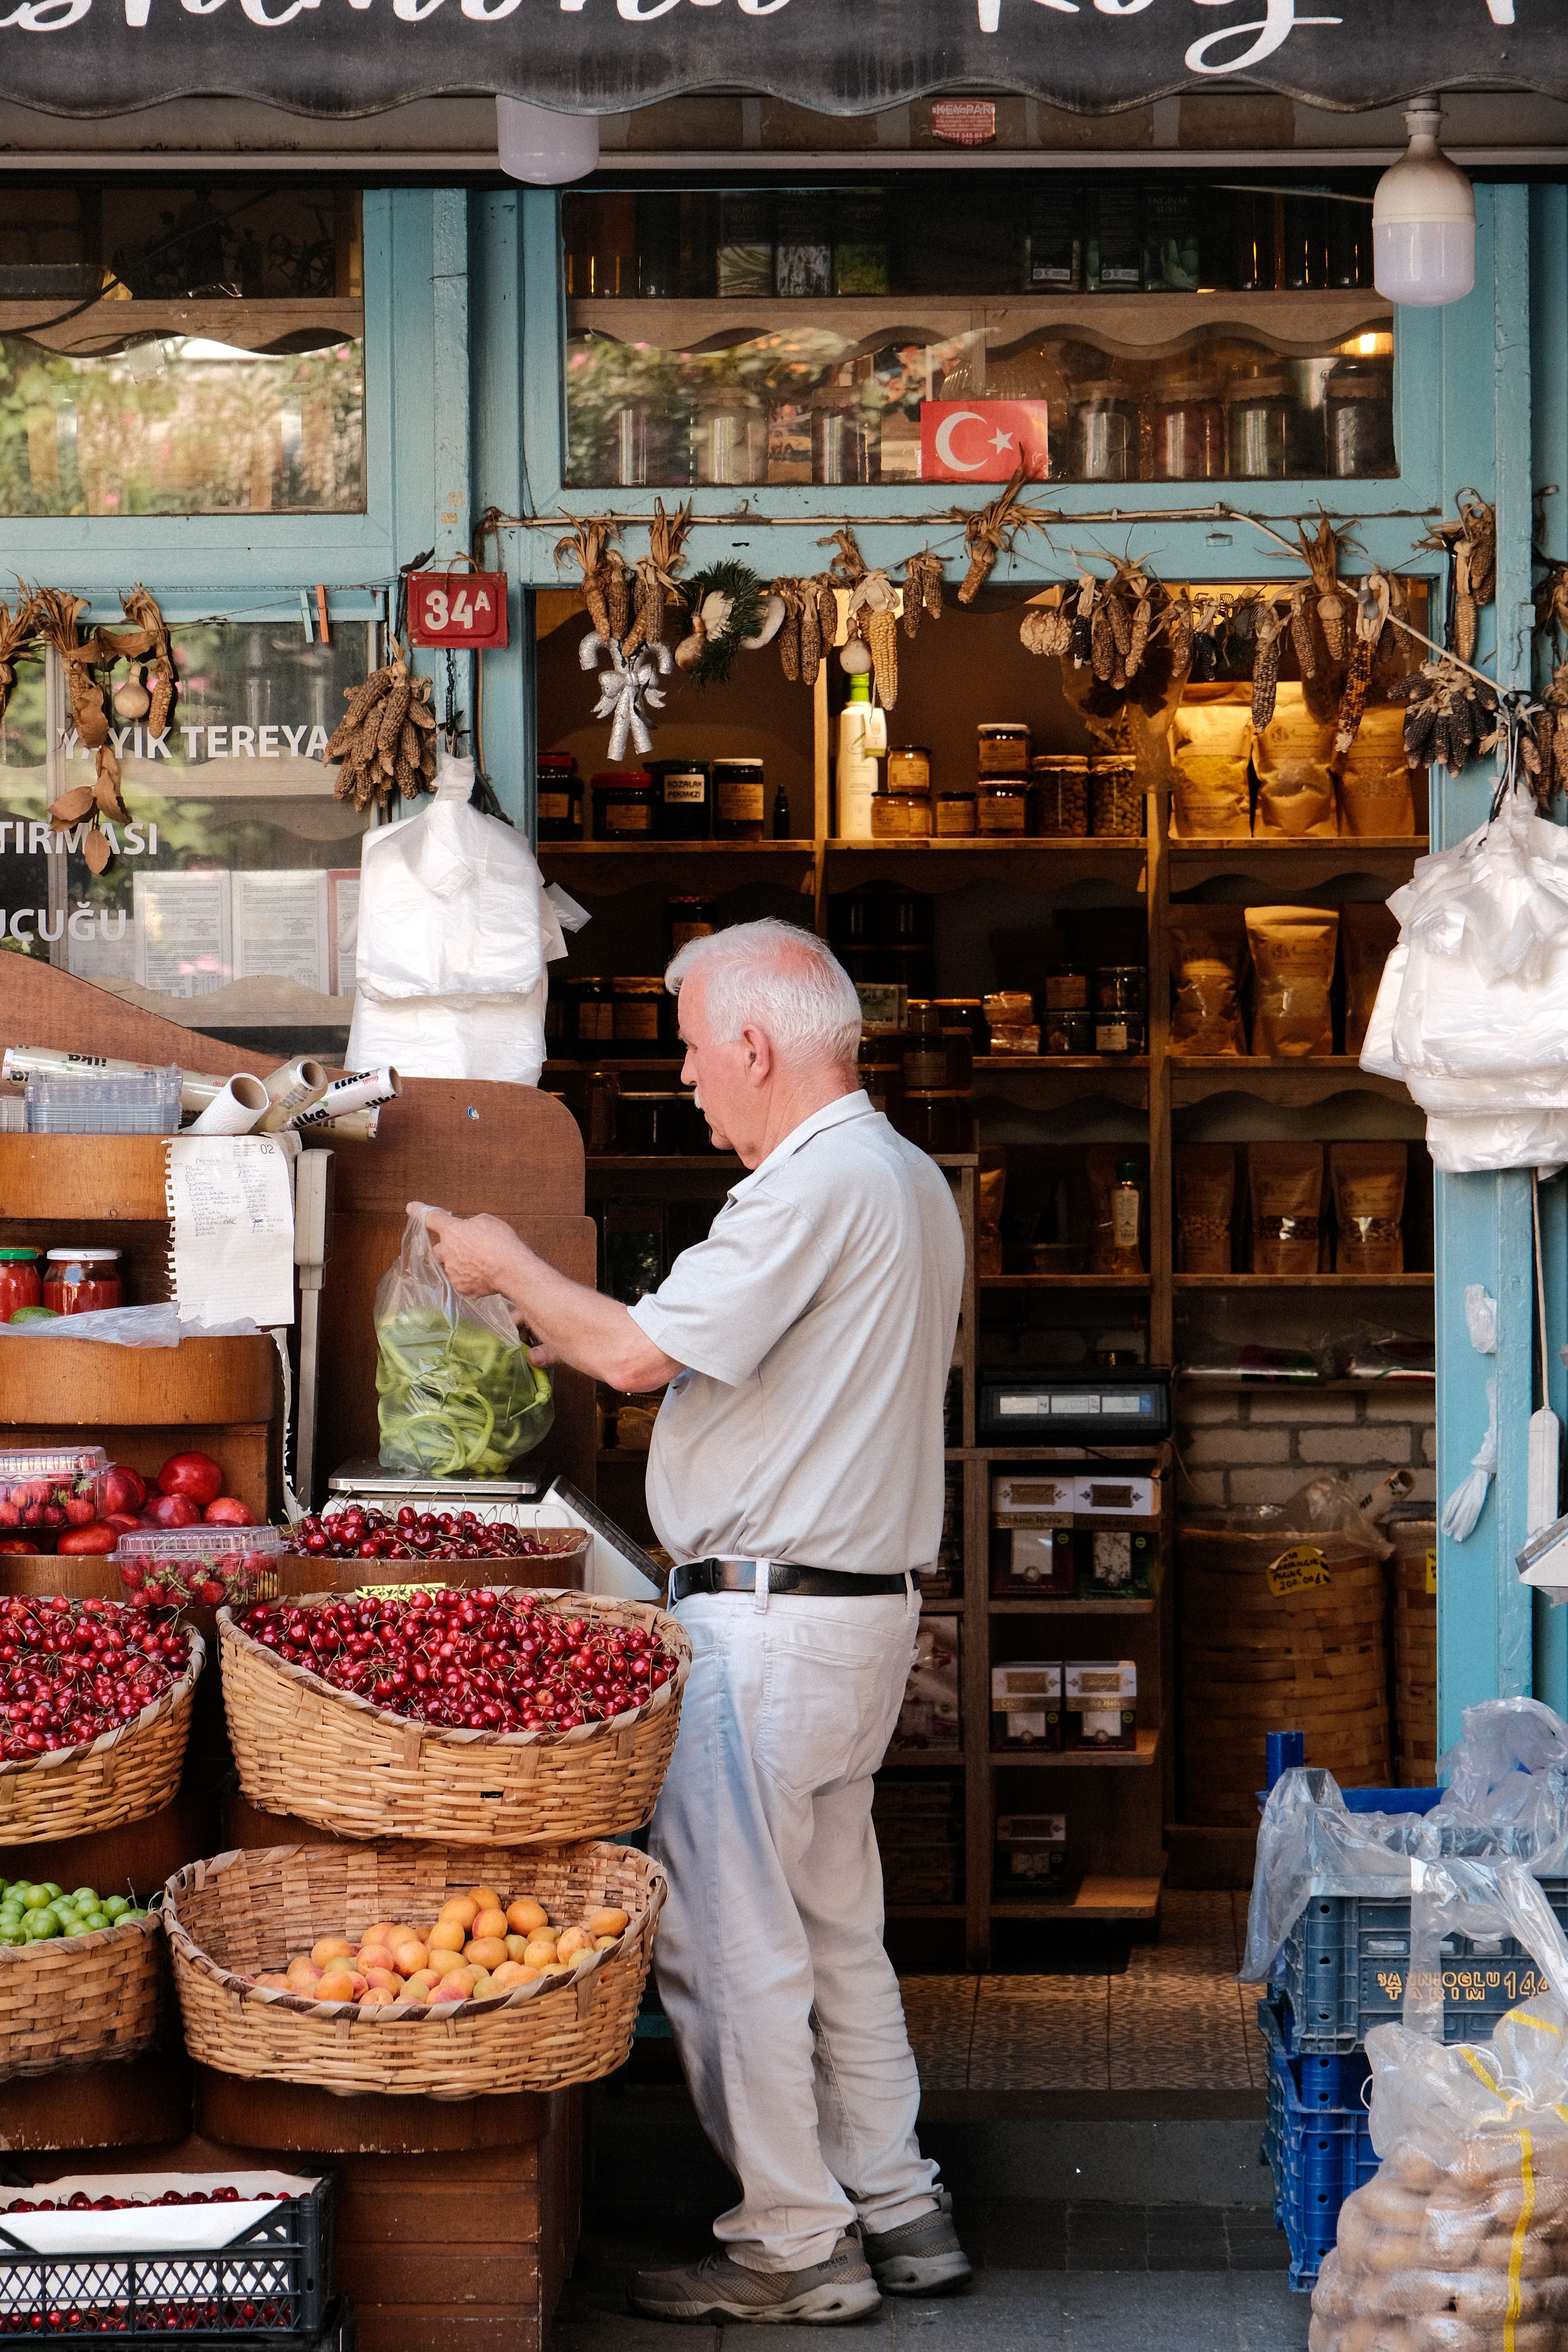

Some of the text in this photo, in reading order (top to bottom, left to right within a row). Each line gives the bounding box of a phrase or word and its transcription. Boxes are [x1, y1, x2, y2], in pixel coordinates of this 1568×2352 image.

[425, 589, 491, 630] 34A
[55, 726, 173, 760] YYIK
[292, 1108, 330, 1128] ilka
[260, 1144, 275, 1154] 02
